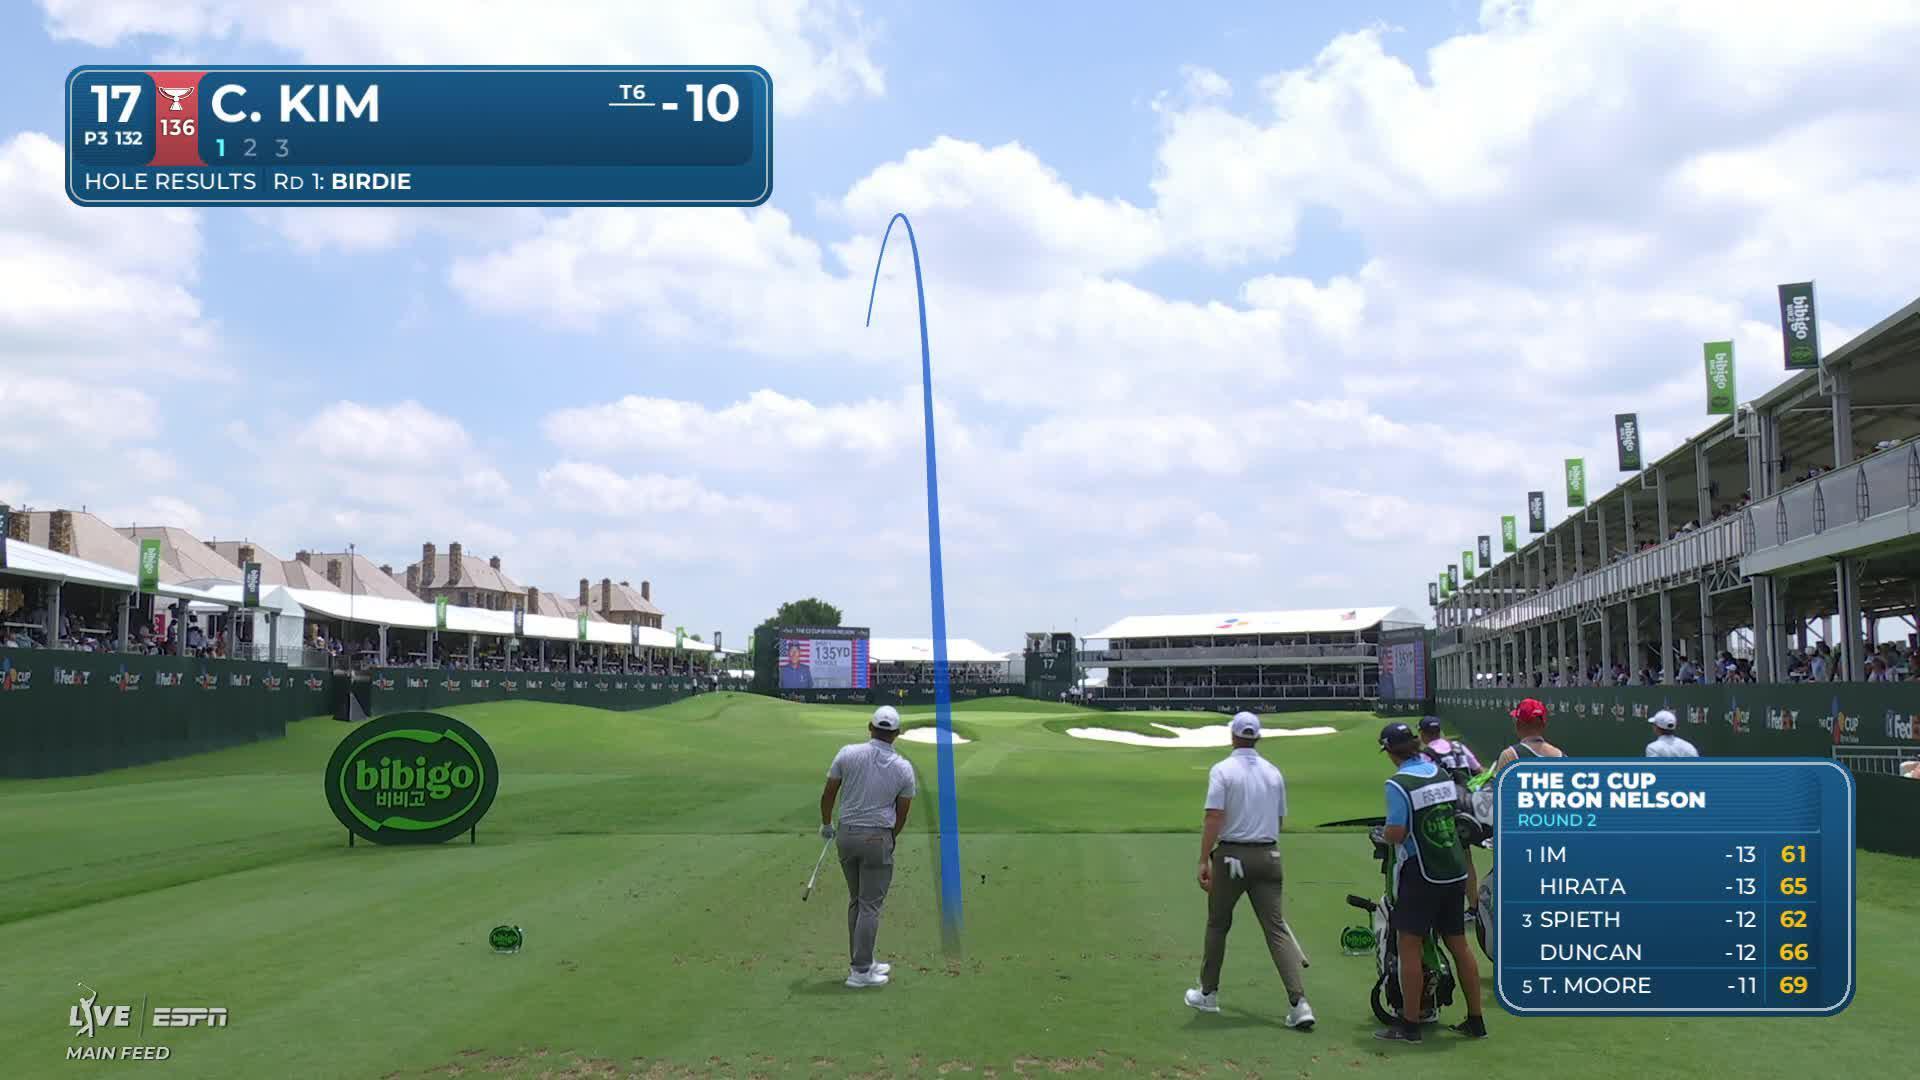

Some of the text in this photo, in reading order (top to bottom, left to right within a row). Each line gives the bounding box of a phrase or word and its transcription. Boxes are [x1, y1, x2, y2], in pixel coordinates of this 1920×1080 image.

[1791, 295, 1811, 341] bibigo
[1713, 352, 1729, 389] bibigo
[1622, 421, 1636, 452] bibigo
[356, 756, 474, 799] bibigo
[376, 791, 426, 808] 비비고
